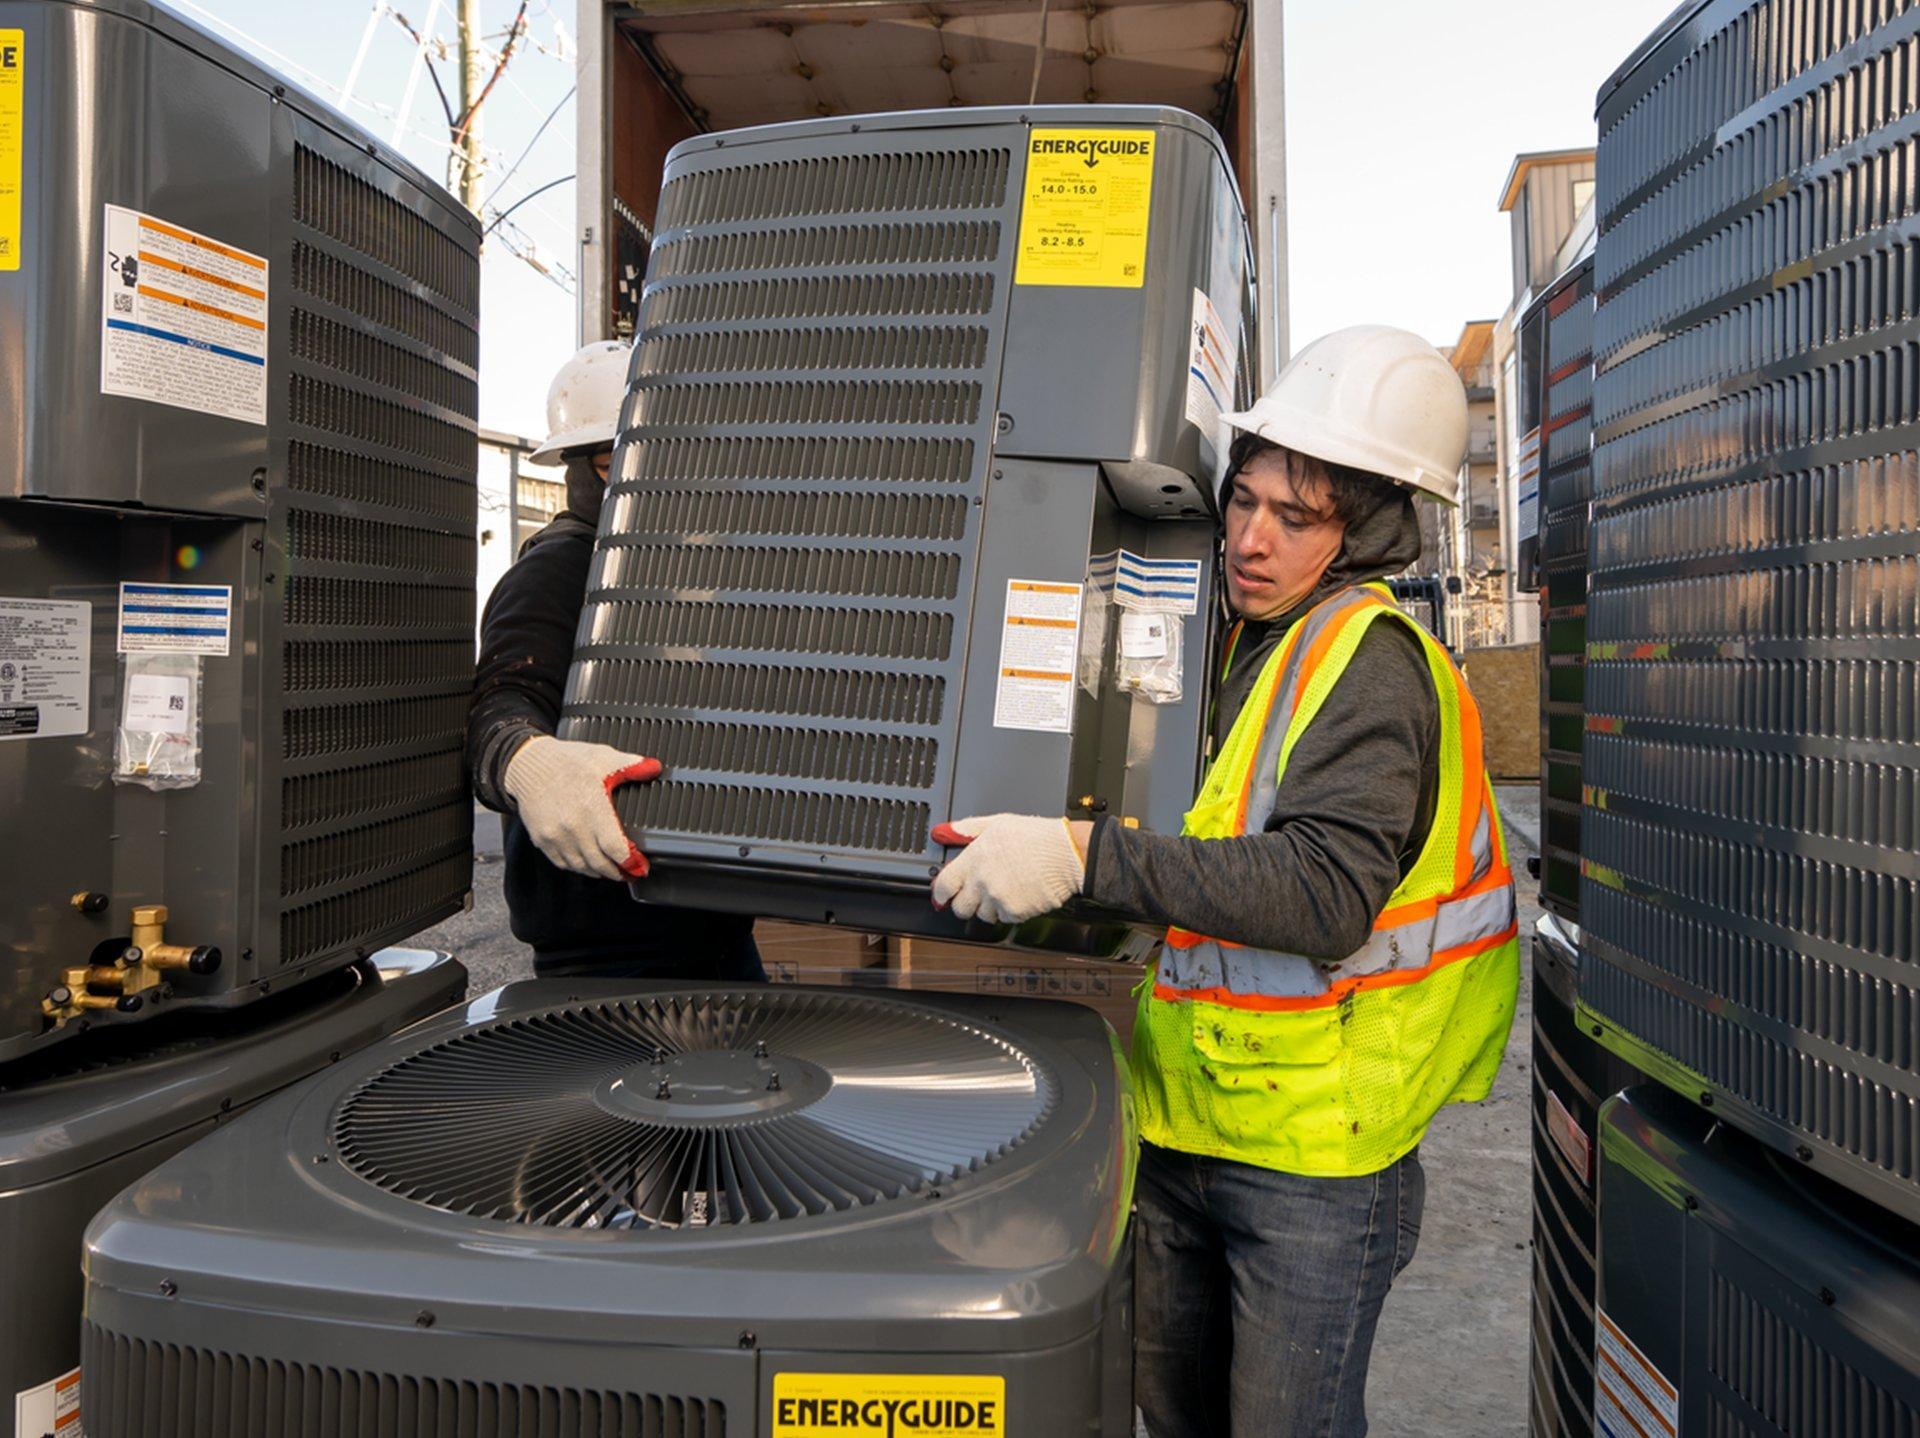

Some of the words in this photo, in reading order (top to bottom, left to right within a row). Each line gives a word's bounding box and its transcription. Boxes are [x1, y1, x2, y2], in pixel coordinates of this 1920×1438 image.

[1032, 140, 1149, 155] ENERGYGUIDE
[1041, 185, 1065, 194] 14.0
[1073, 185, 1097, 194] 15.0
[1040, 237, 1060, 246] 8.2
[778, 1398, 996, 1430] ENERGYGUIDE
